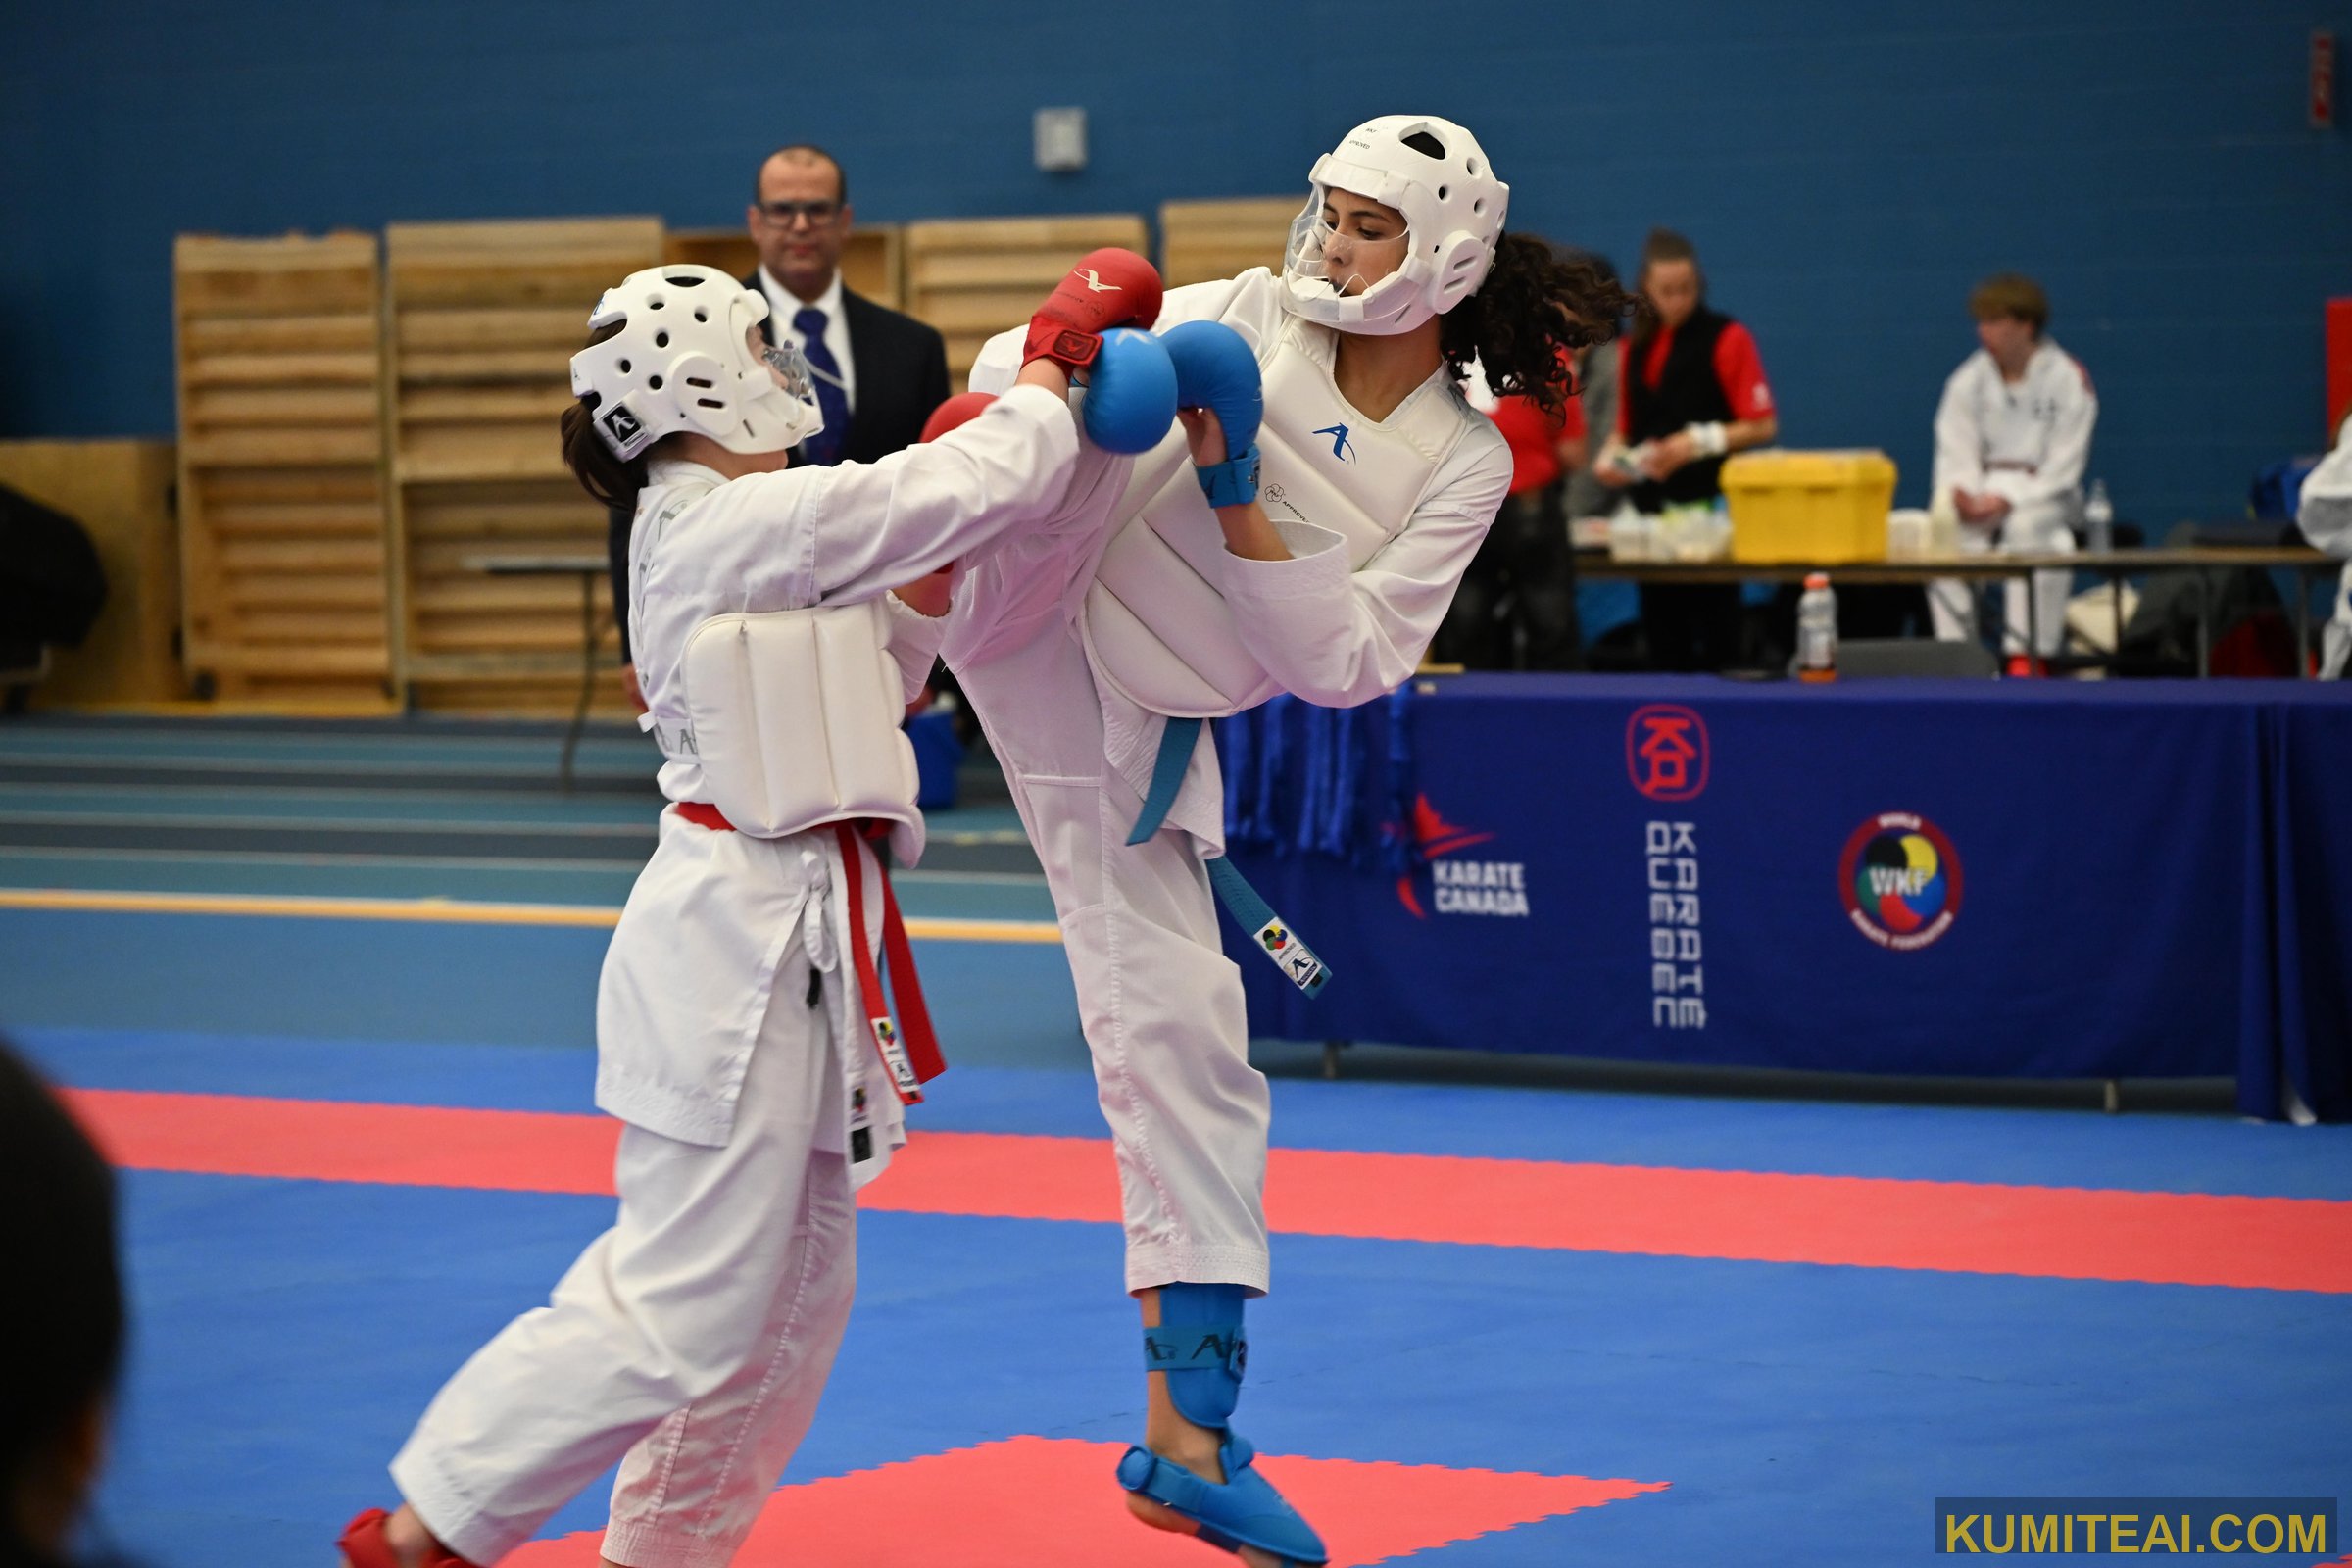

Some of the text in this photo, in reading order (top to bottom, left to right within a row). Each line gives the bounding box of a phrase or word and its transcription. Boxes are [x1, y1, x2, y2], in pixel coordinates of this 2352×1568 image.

[1432, 860, 1525, 890] KARATE
[1868, 866, 1929, 896] WKF
[1435, 887, 1530, 917] CANADA
